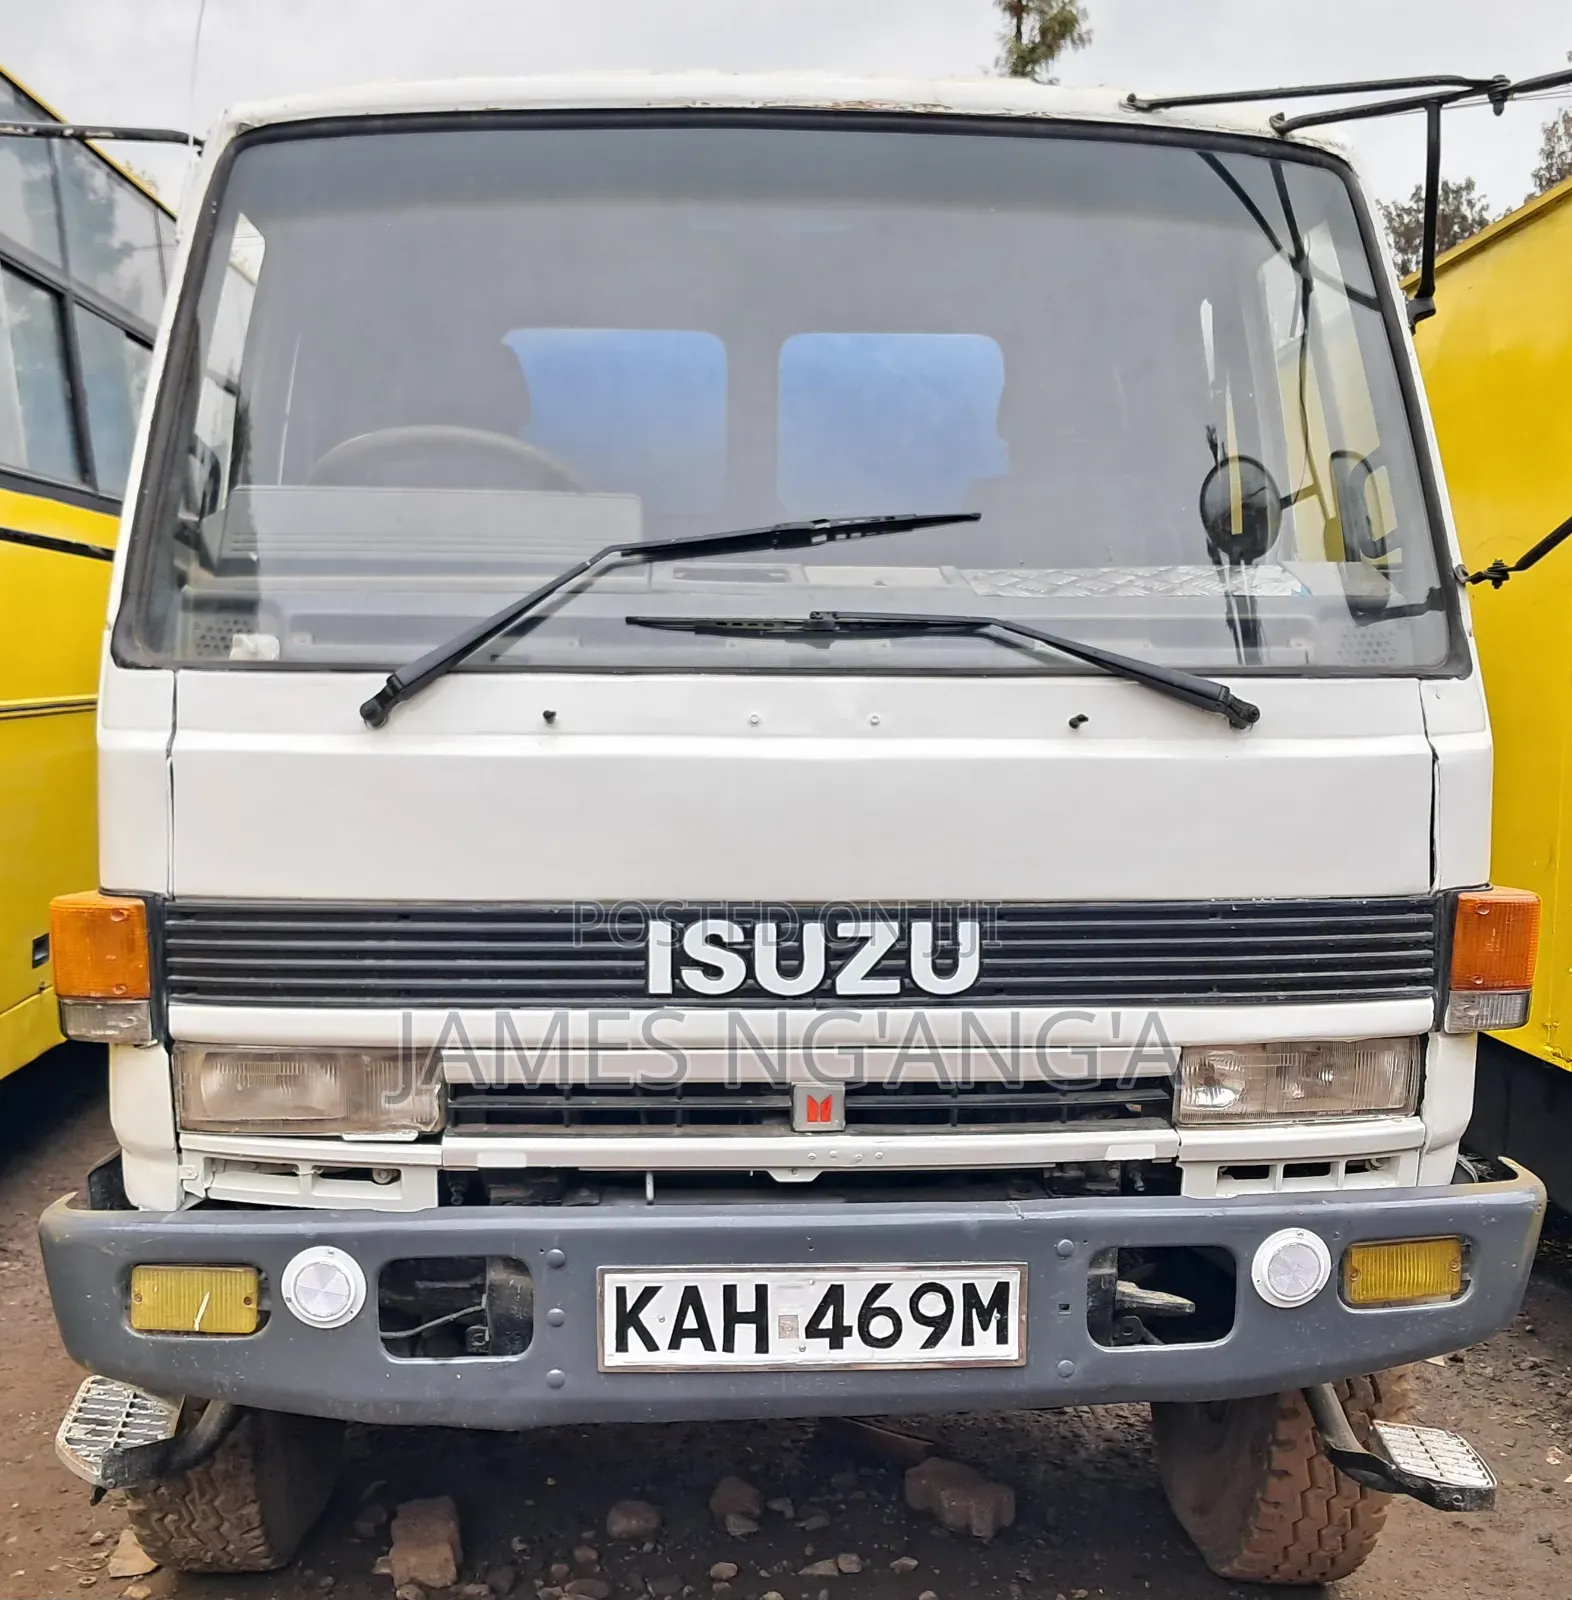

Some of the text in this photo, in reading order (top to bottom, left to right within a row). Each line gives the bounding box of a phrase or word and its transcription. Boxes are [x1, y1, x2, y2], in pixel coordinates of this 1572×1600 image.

[648, 918, 980, 996] ISUZU
[614, 1281, 1011, 1354] KAH 469M
